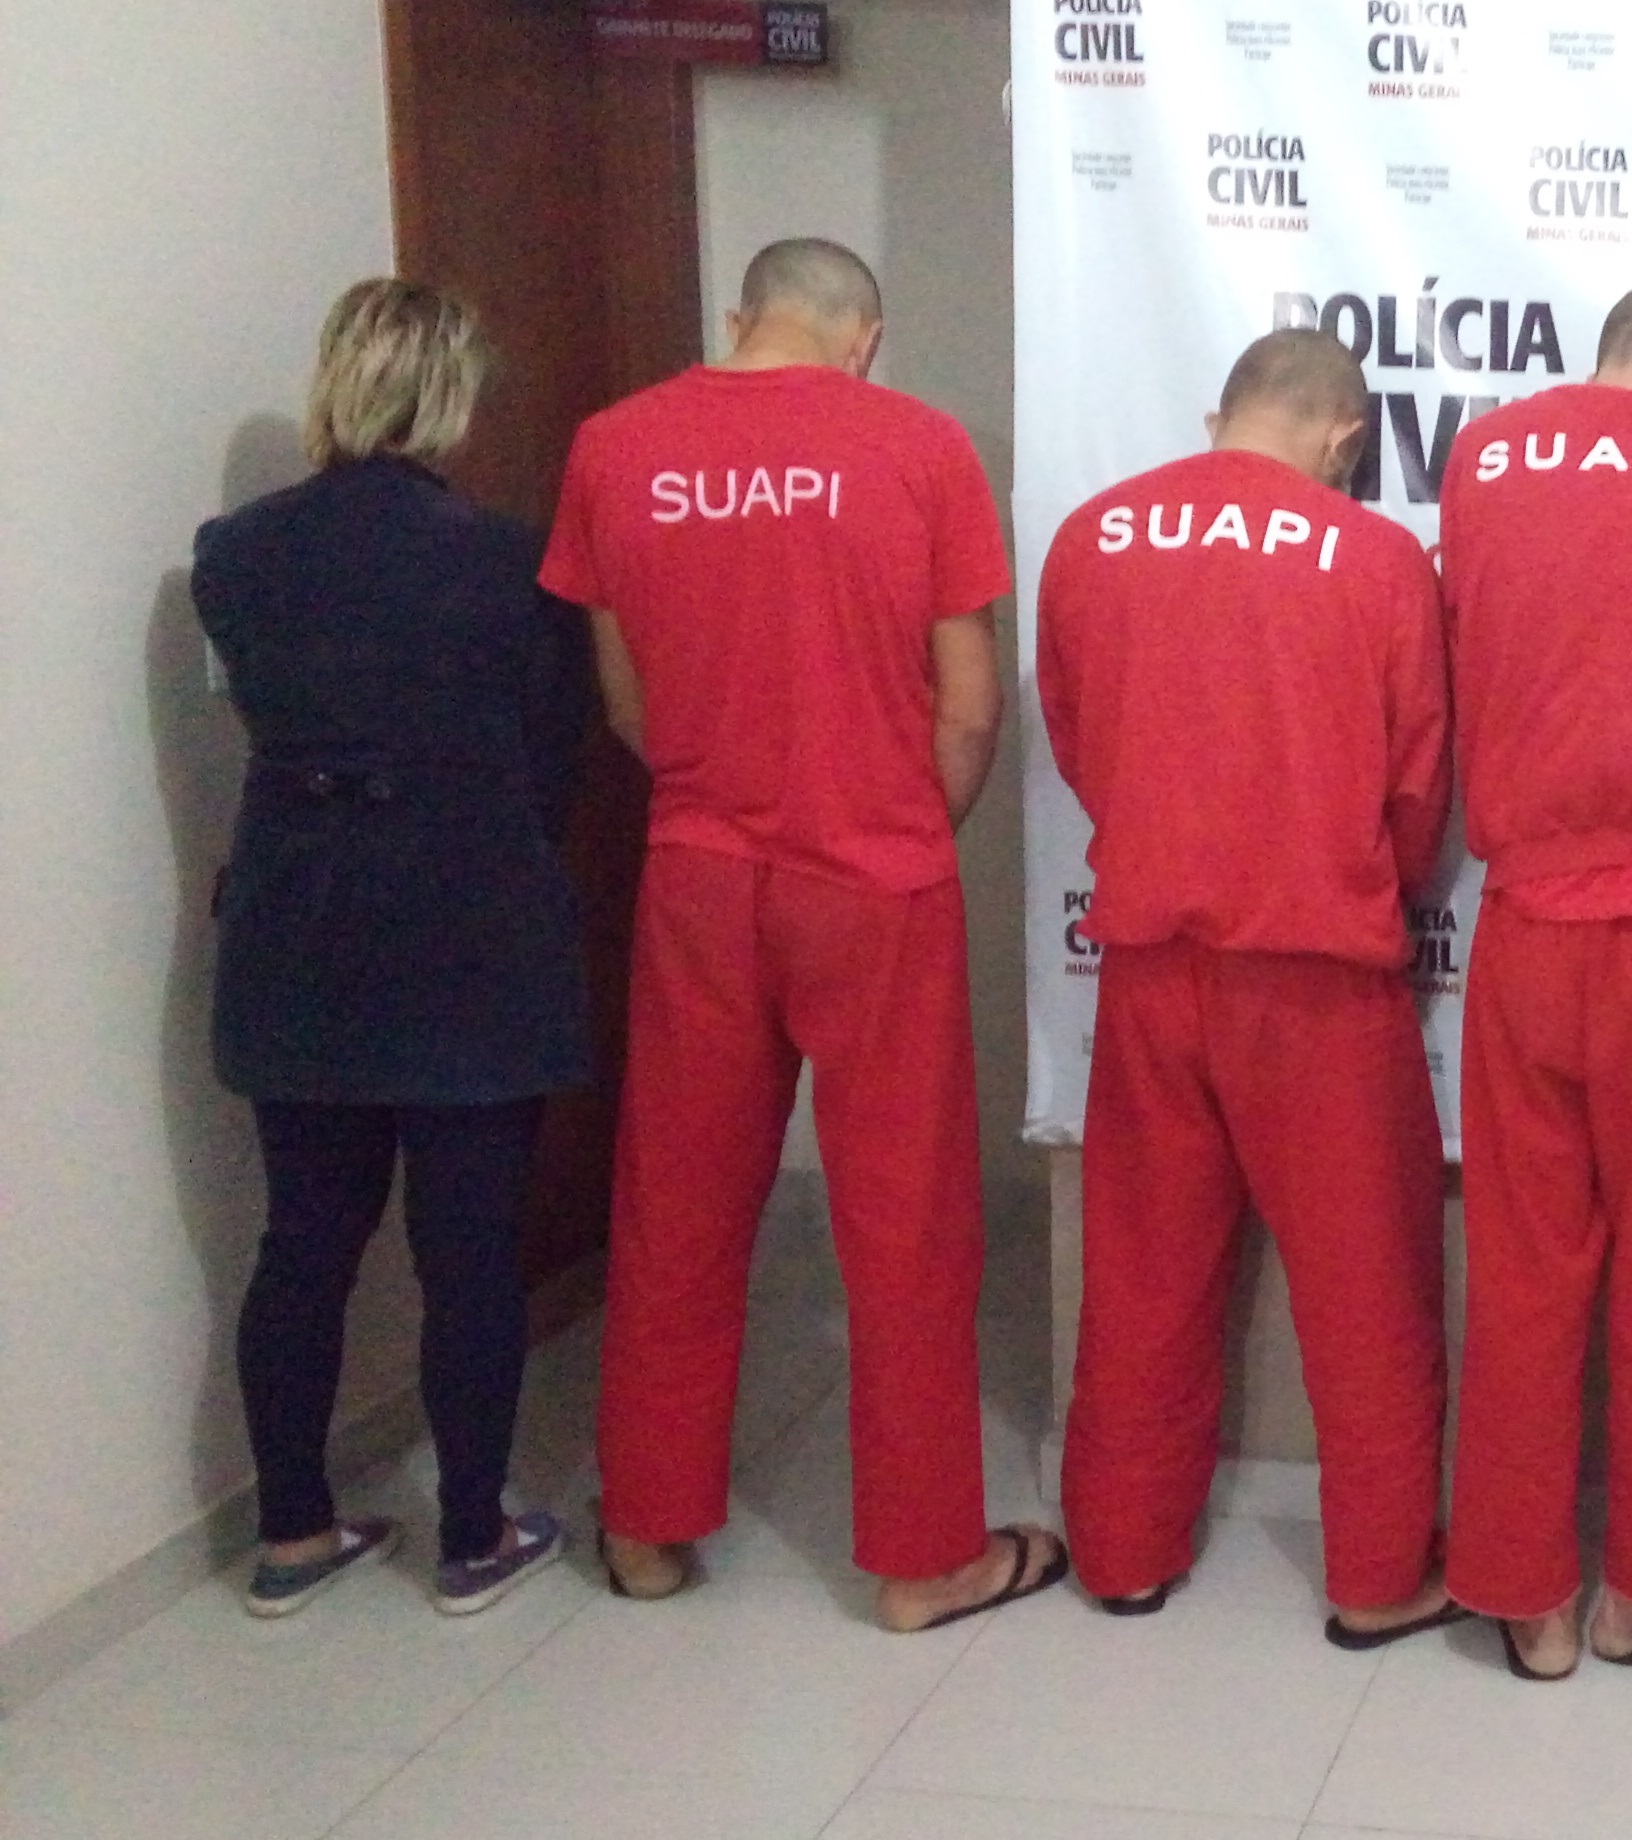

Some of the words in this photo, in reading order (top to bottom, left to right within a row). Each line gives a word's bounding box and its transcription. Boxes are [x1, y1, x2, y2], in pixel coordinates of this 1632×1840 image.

[768, 28, 821, 53] CIVIL
[1054, 23, 1144, 62] CIVIL
[1054, 70, 1098, 86] MINAS
[1103, 71, 1146, 87] GERAIS
[1368, 81, 1413, 97] MINAS
[1207, 129, 1305, 162] POLÍCIA
[1529, 141, 1628, 173] POLÍCIA
[1207, 166, 1308, 207] CIVIL
[1528, 179, 1629, 219] CIVIL
[1207, 213, 1254, 230] MINAS
[1259, 215, 1309, 233] GERAIS
[651, 467, 839, 523] SUAPI
[1098, 503, 1339, 572] SUAPI
